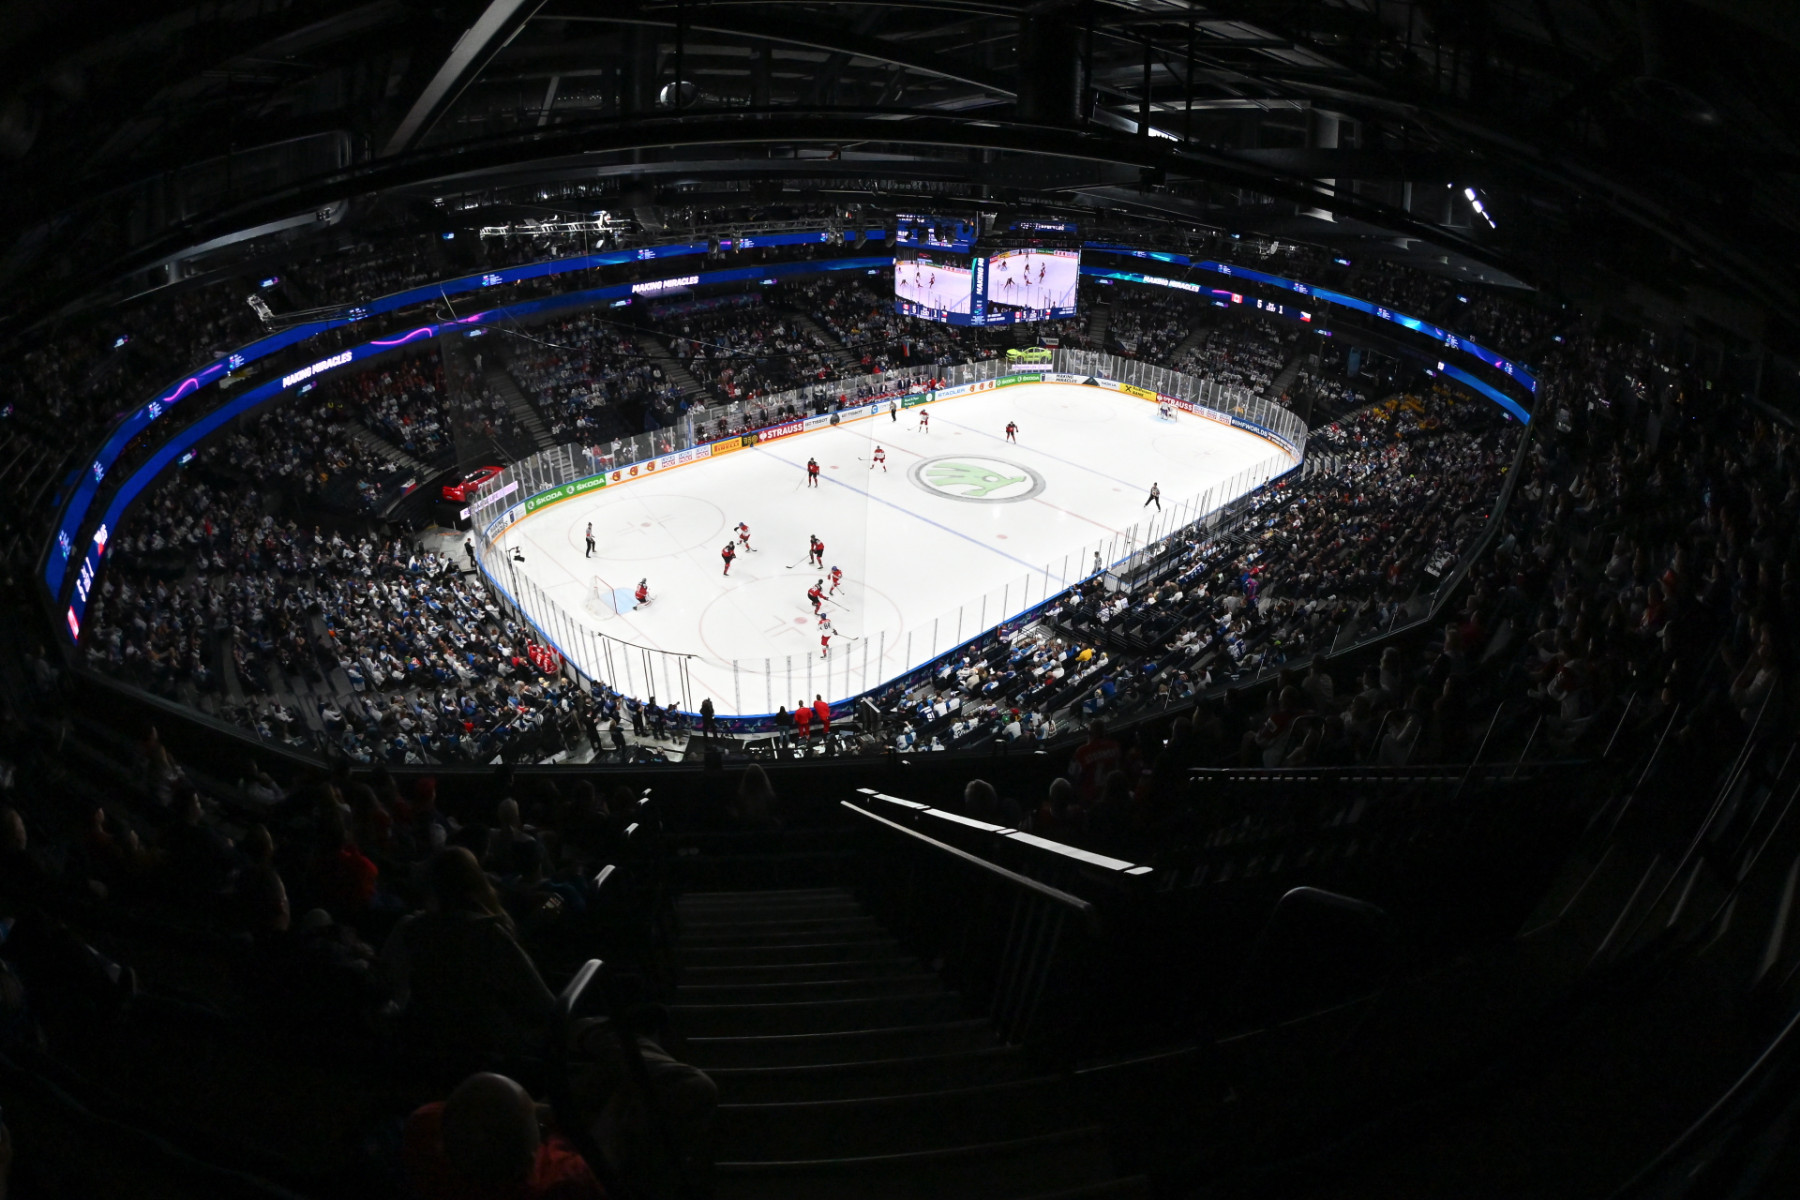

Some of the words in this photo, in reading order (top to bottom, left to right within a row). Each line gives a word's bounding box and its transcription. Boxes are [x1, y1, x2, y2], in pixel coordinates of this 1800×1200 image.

[632, 281, 662, 293] MAKING
[663, 275, 699, 289] MIRACLES
[1143, 275, 1169, 286] MAKING
[1168, 280, 1200, 293] MIRACLES
[1257, 299, 1262, 309] 5
[1278, 305, 1283, 314] 1
[282, 366, 312, 388] MAKING
[312, 351, 353, 374] MIRACLES
[938, 388, 966, 397] STADLER
[1163, 396, 1193, 412] STRAUSS
[812, 417, 828, 425] TISSOT
[767, 422, 803, 438] STRAUSS
[576, 478, 604, 491] ŠKODA
[535, 490, 563, 506] ŠKODA
